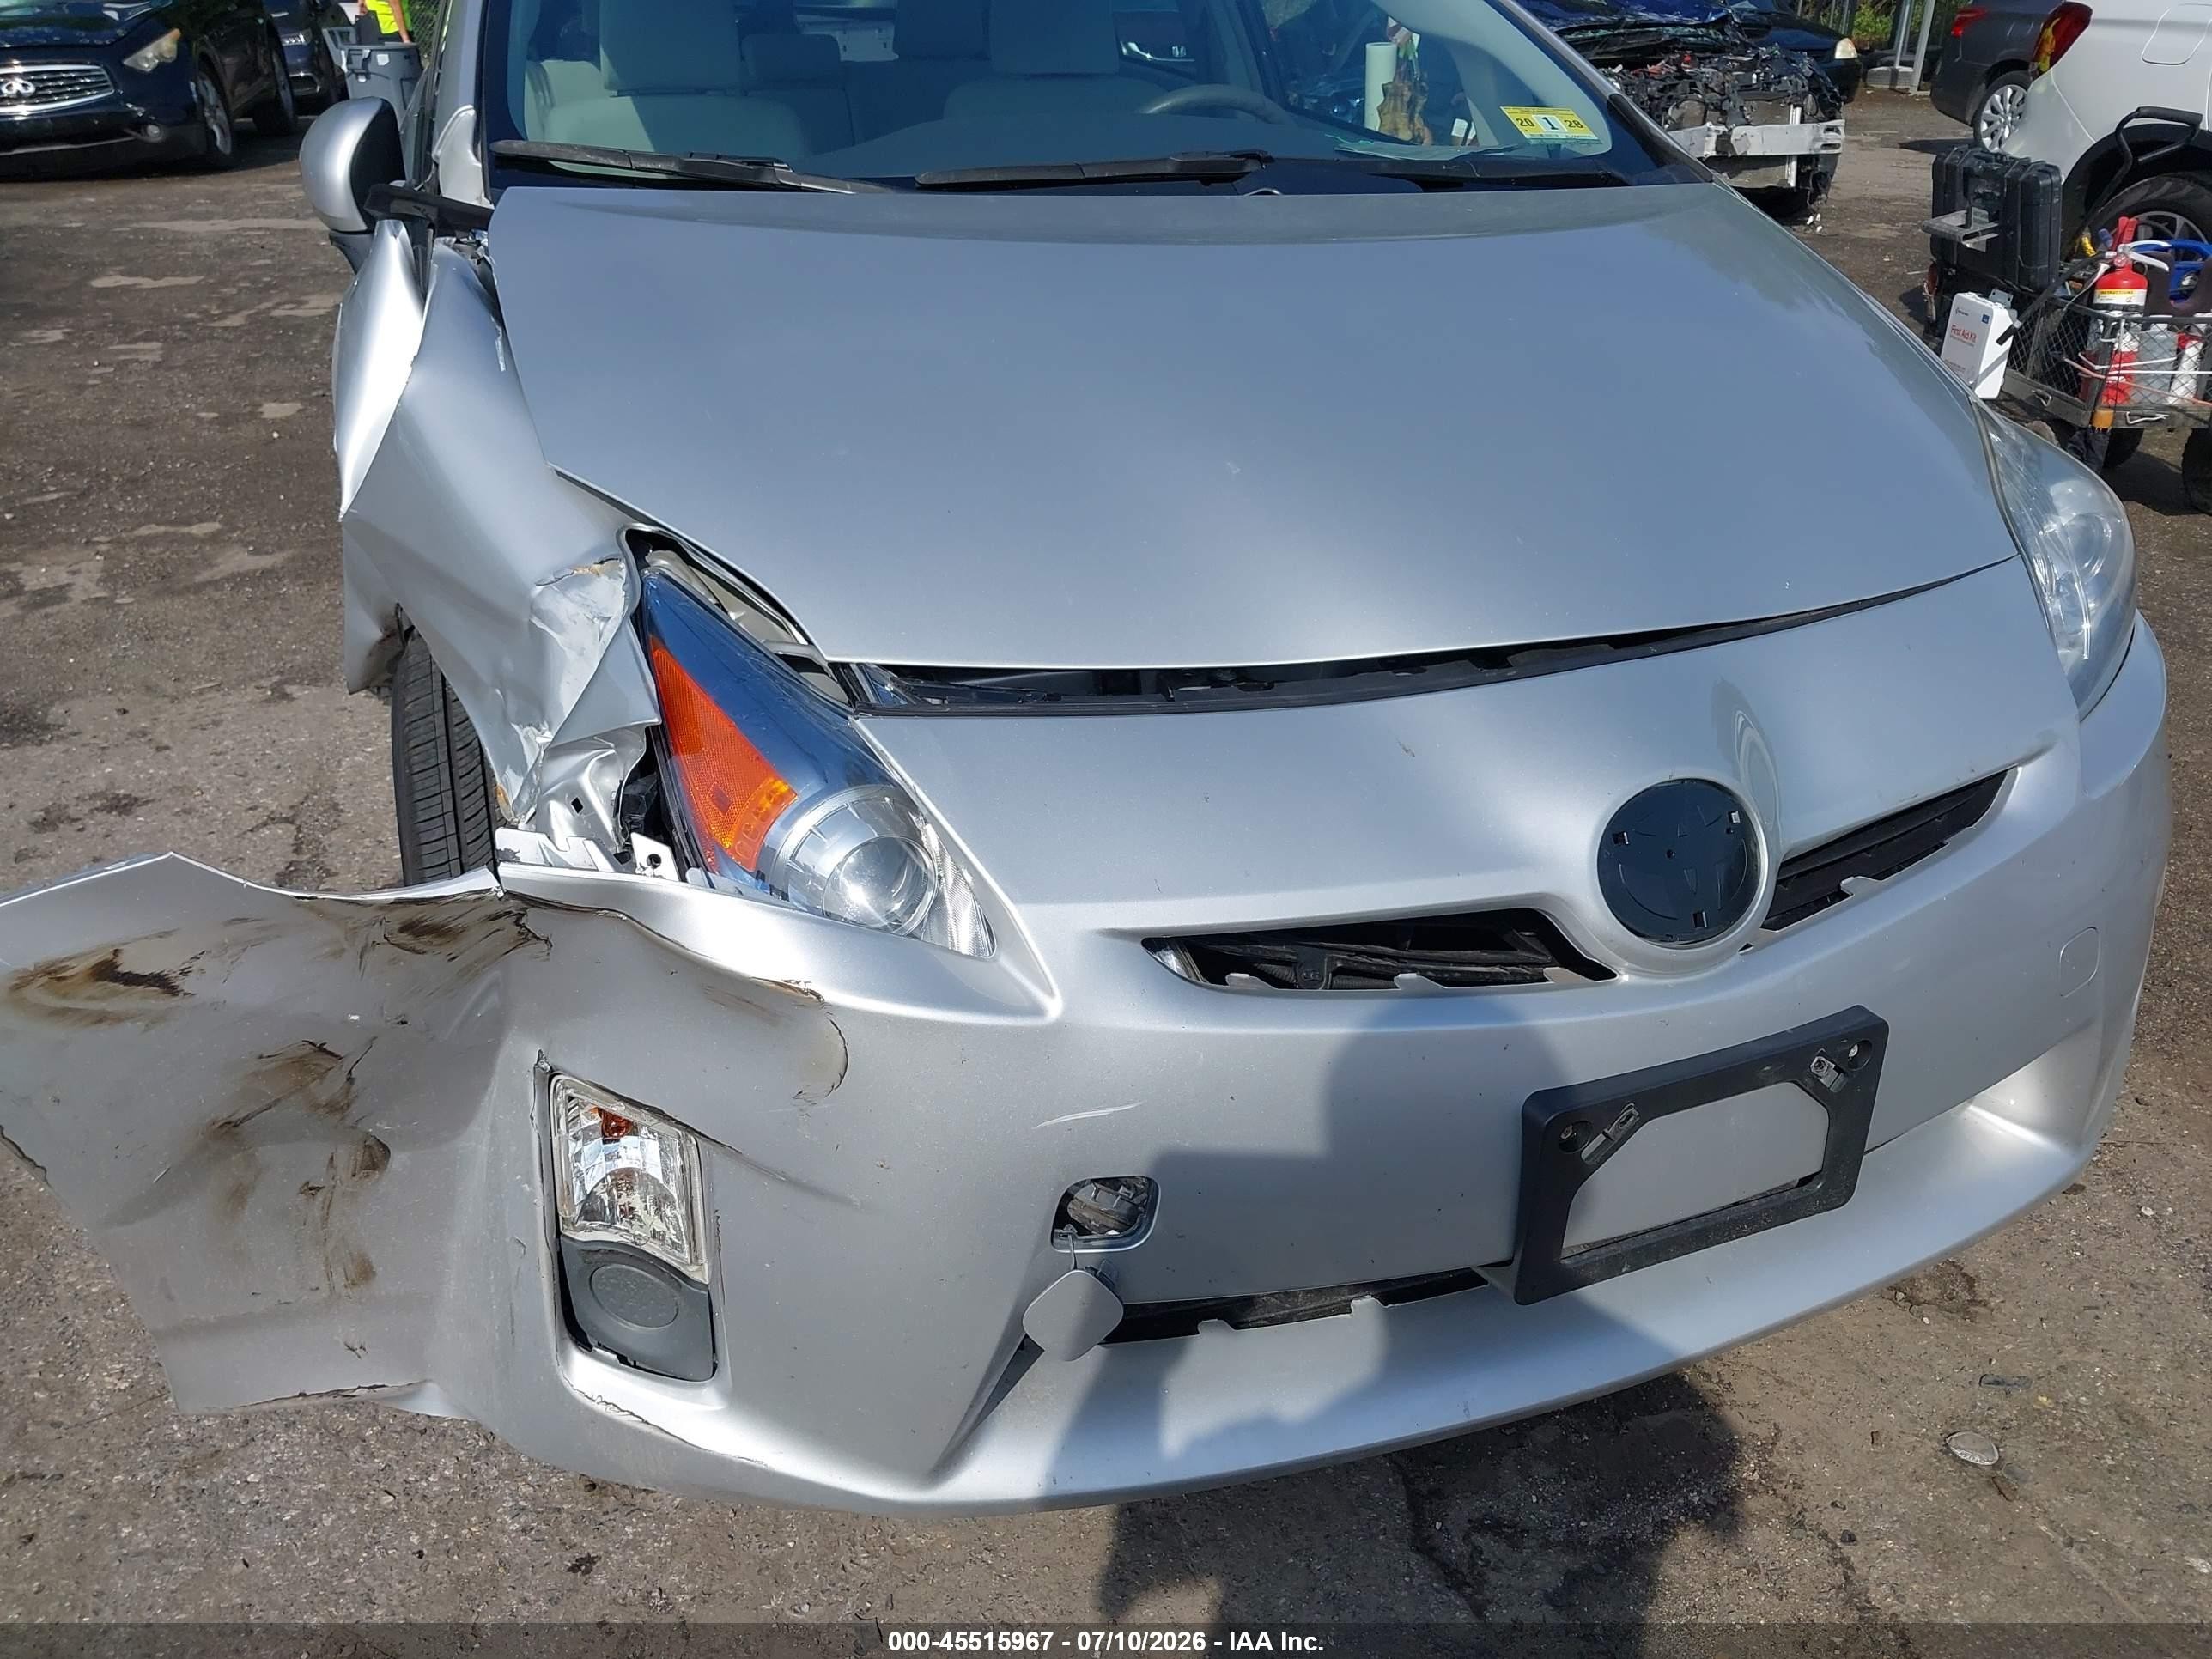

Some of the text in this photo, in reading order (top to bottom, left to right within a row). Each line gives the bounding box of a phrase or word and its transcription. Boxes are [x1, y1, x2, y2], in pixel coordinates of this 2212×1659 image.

[1516, 117, 1583, 130] 20 1 28
